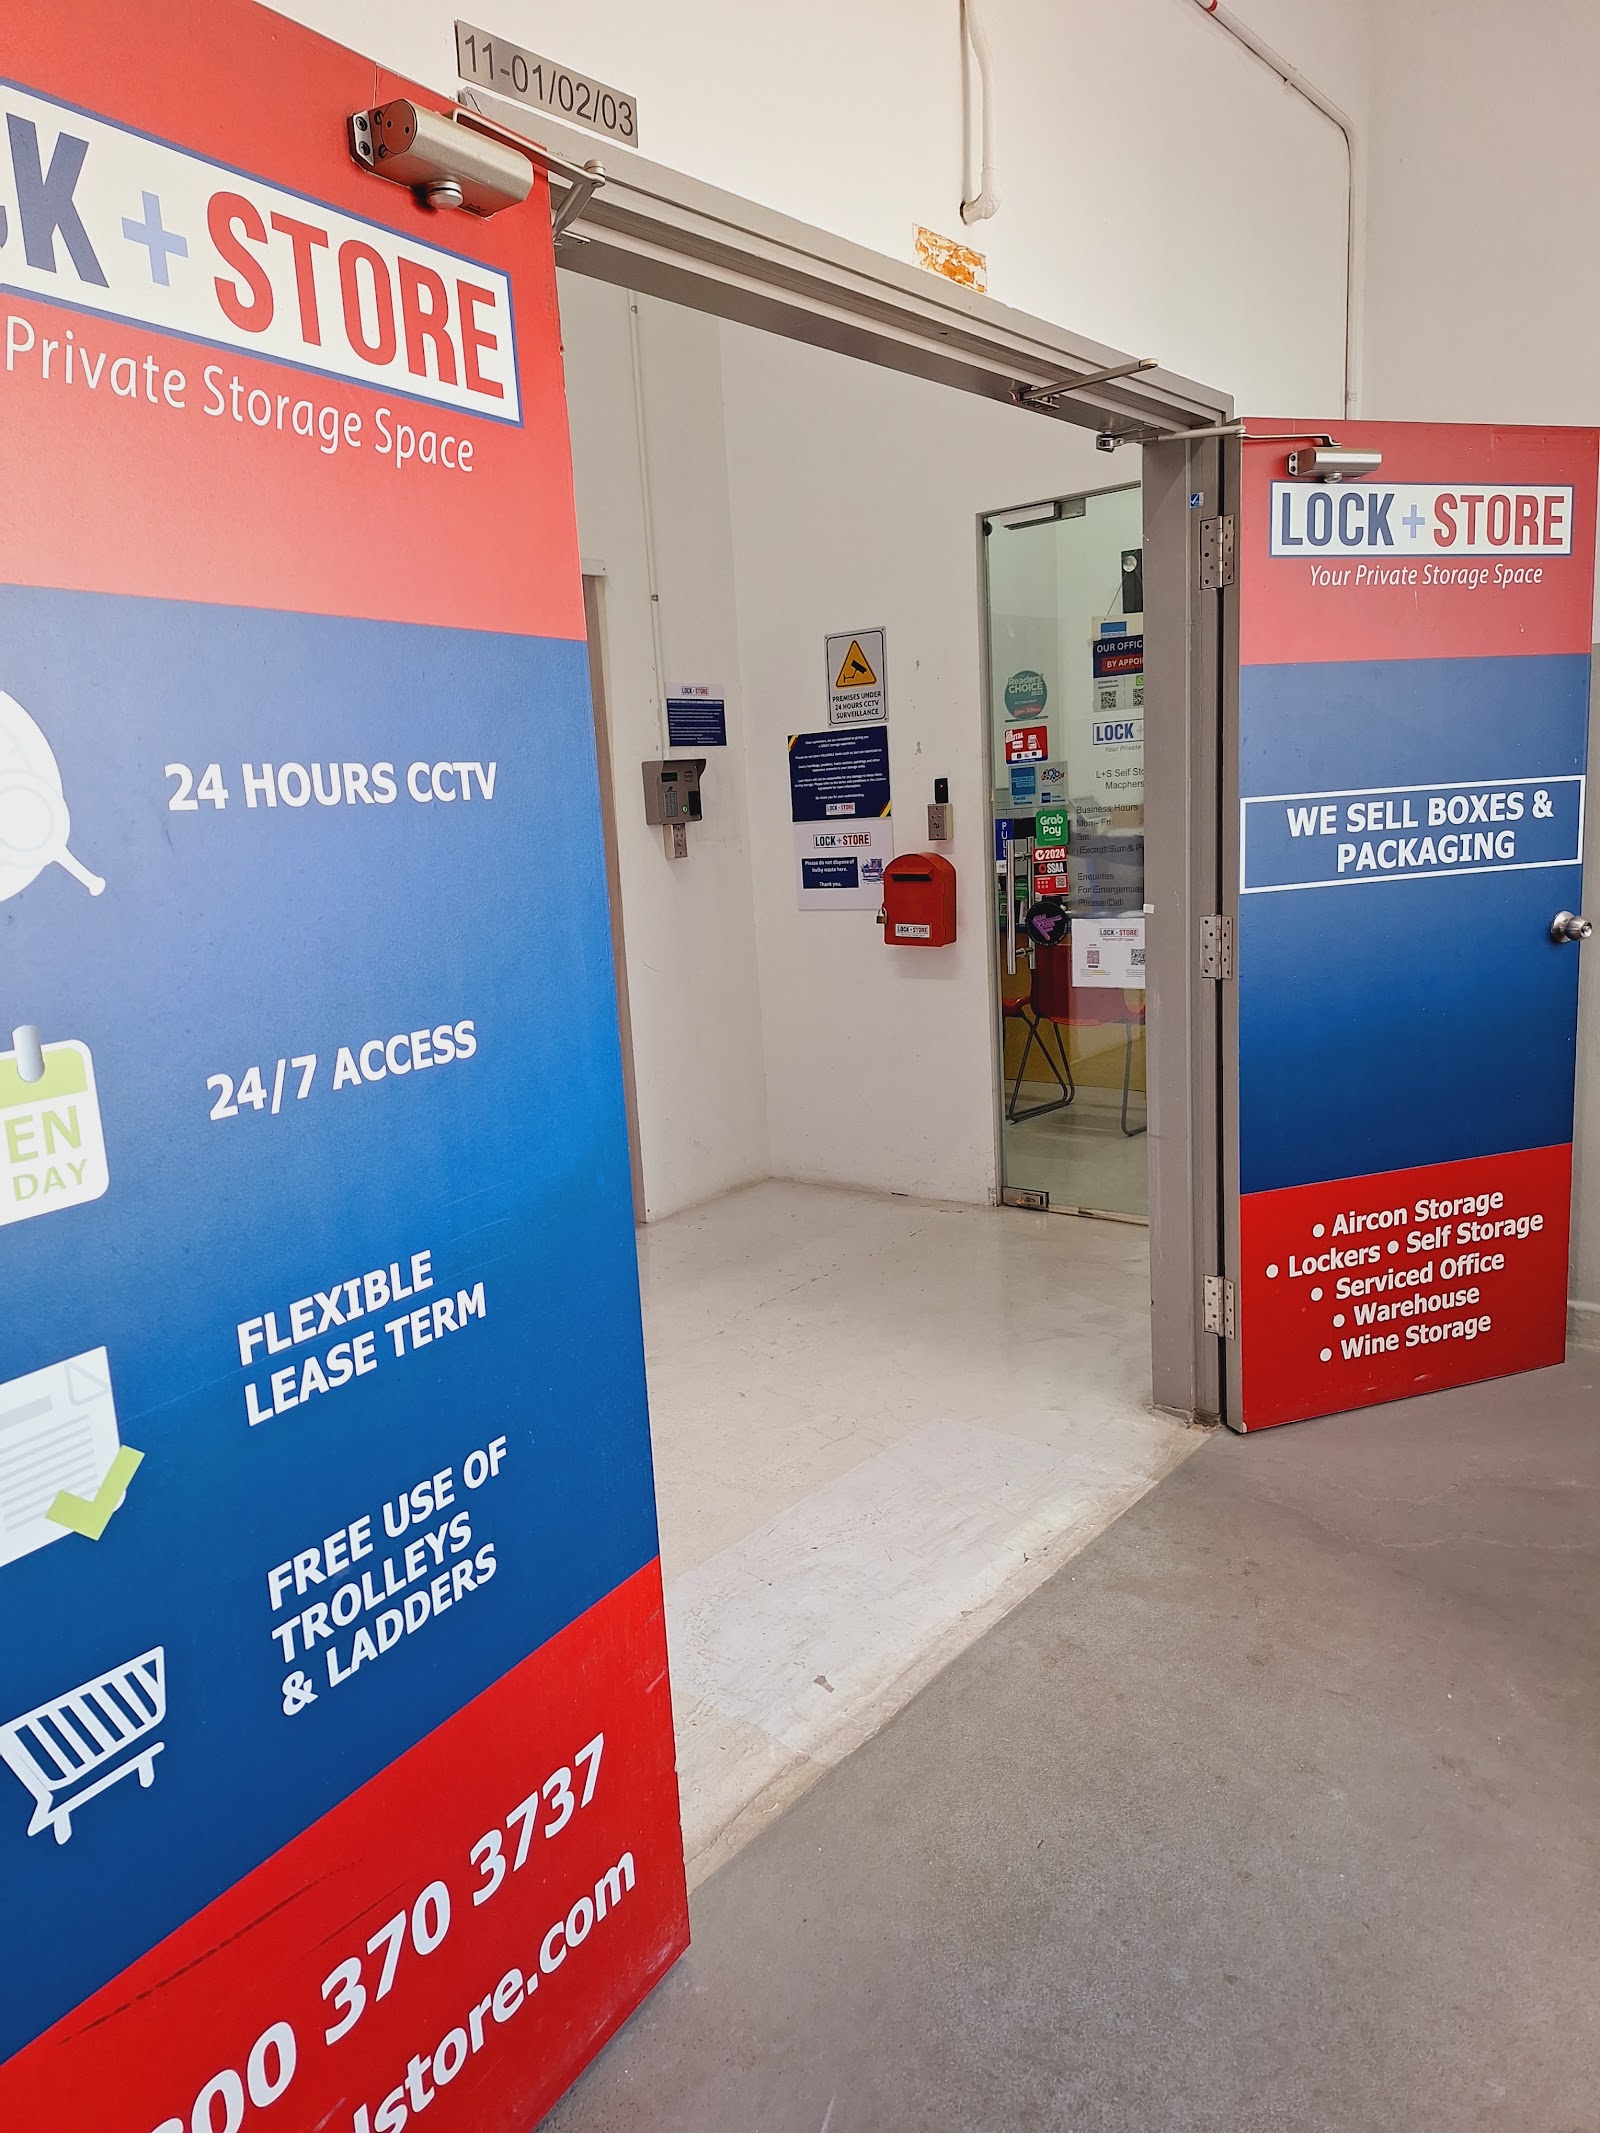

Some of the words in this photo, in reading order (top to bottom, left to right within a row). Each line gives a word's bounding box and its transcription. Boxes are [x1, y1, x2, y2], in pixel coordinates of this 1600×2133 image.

[464, 34, 634, 137] 11-01/02/03
[0, 112, 109, 288] K
[206, 191, 504, 400] STORE
[6, 315, 187, 409] Private
[203, 365, 362, 455] Storage
[374, 408, 474, 473] Space
[1281, 491, 1395, 546] LOCK
[1434, 493, 1565, 547] STORE
[1310, 565, 1351, 587] Your
[1355, 563, 1417, 586] Private
[1422, 563, 1488, 589] Storage
[1493, 563, 1543, 588] Space
[1096, 643, 1115, 653] OUR
[1117, 640, 1143, 651] OFFIC
[1106, 660, 1117, 668] BY
[1118, 657, 1143, 667] APPOI
[832, 693, 860, 702] PREMISES
[861, 691, 882, 699] UNDER
[843, 701, 863, 710] HOURS
[864, 700, 880, 708] CCTV
[1008, 681, 1043, 694] CHOICE
[836, 708, 879, 719] SURVEILLANCE
[1096, 723, 1134, 741] LOCK
[164, 763, 228, 811] 24
[242, 761, 397, 808] HOURS
[407, 761, 497, 803] CCTV
[1096, 769, 1112, 779] L+S
[1115, 768, 1131, 777] Self
[1040, 814, 1064, 826] Grab
[1043, 826, 1062, 837] Pay
[1076, 805, 1111, 814] Business
[1114, 804, 1138, 812] Hours
[1287, 805, 1337, 838] WE
[1346, 800, 1418, 833] SELL
[1428, 791, 1524, 826] BOXES
[1532, 789, 1554, 818] &
[815, 835, 836, 847] LOCK
[842, 834, 870, 845] STORE
[1045, 848, 1065, 859] 2024
[1337, 830, 1515, 873] PACKAGING
[1046, 862, 1064, 873] SSAA
[206, 1053, 317, 1121] 24/7
[332, 1020, 477, 1091] ACCESS
[12, 1157, 88, 1202] DAY
[1332, 1206, 1407, 1238] Aircon
[1414, 1191, 1504, 1223] Storage
[1289, 1244, 1380, 1278] Lockers
[1406, 1225, 1452, 1254] Self
[1456, 1214, 1544, 1246] Storage
[1335, 1261, 1433, 1301] Serviced
[1440, 1252, 1505, 1280] Office
[237, 1249, 434, 1366] FLEXIBLE
[1353, 1286, 1480, 1327] Warehouse
[244, 1330, 378, 1427] LEASE
[385, 1282, 487, 1358] TERM
[1340, 1331, 1399, 1360] Wine
[1405, 1314, 1492, 1347] Storage
[267, 1515, 373, 1610] FREE
[384, 1466, 454, 1538] USE
[462, 1435, 509, 1486] OF
[271, 1511, 473, 1663] TROLLEYS
[281, 1669, 318, 1717] &
[327, 1543, 498, 1687] LADDERS
[150, 2021, 297, 2133] 00
[320, 1879, 452, 2047] 370
[469, 1732, 606, 1907] 3737
[353, 1849, 637, 2133] store.com
